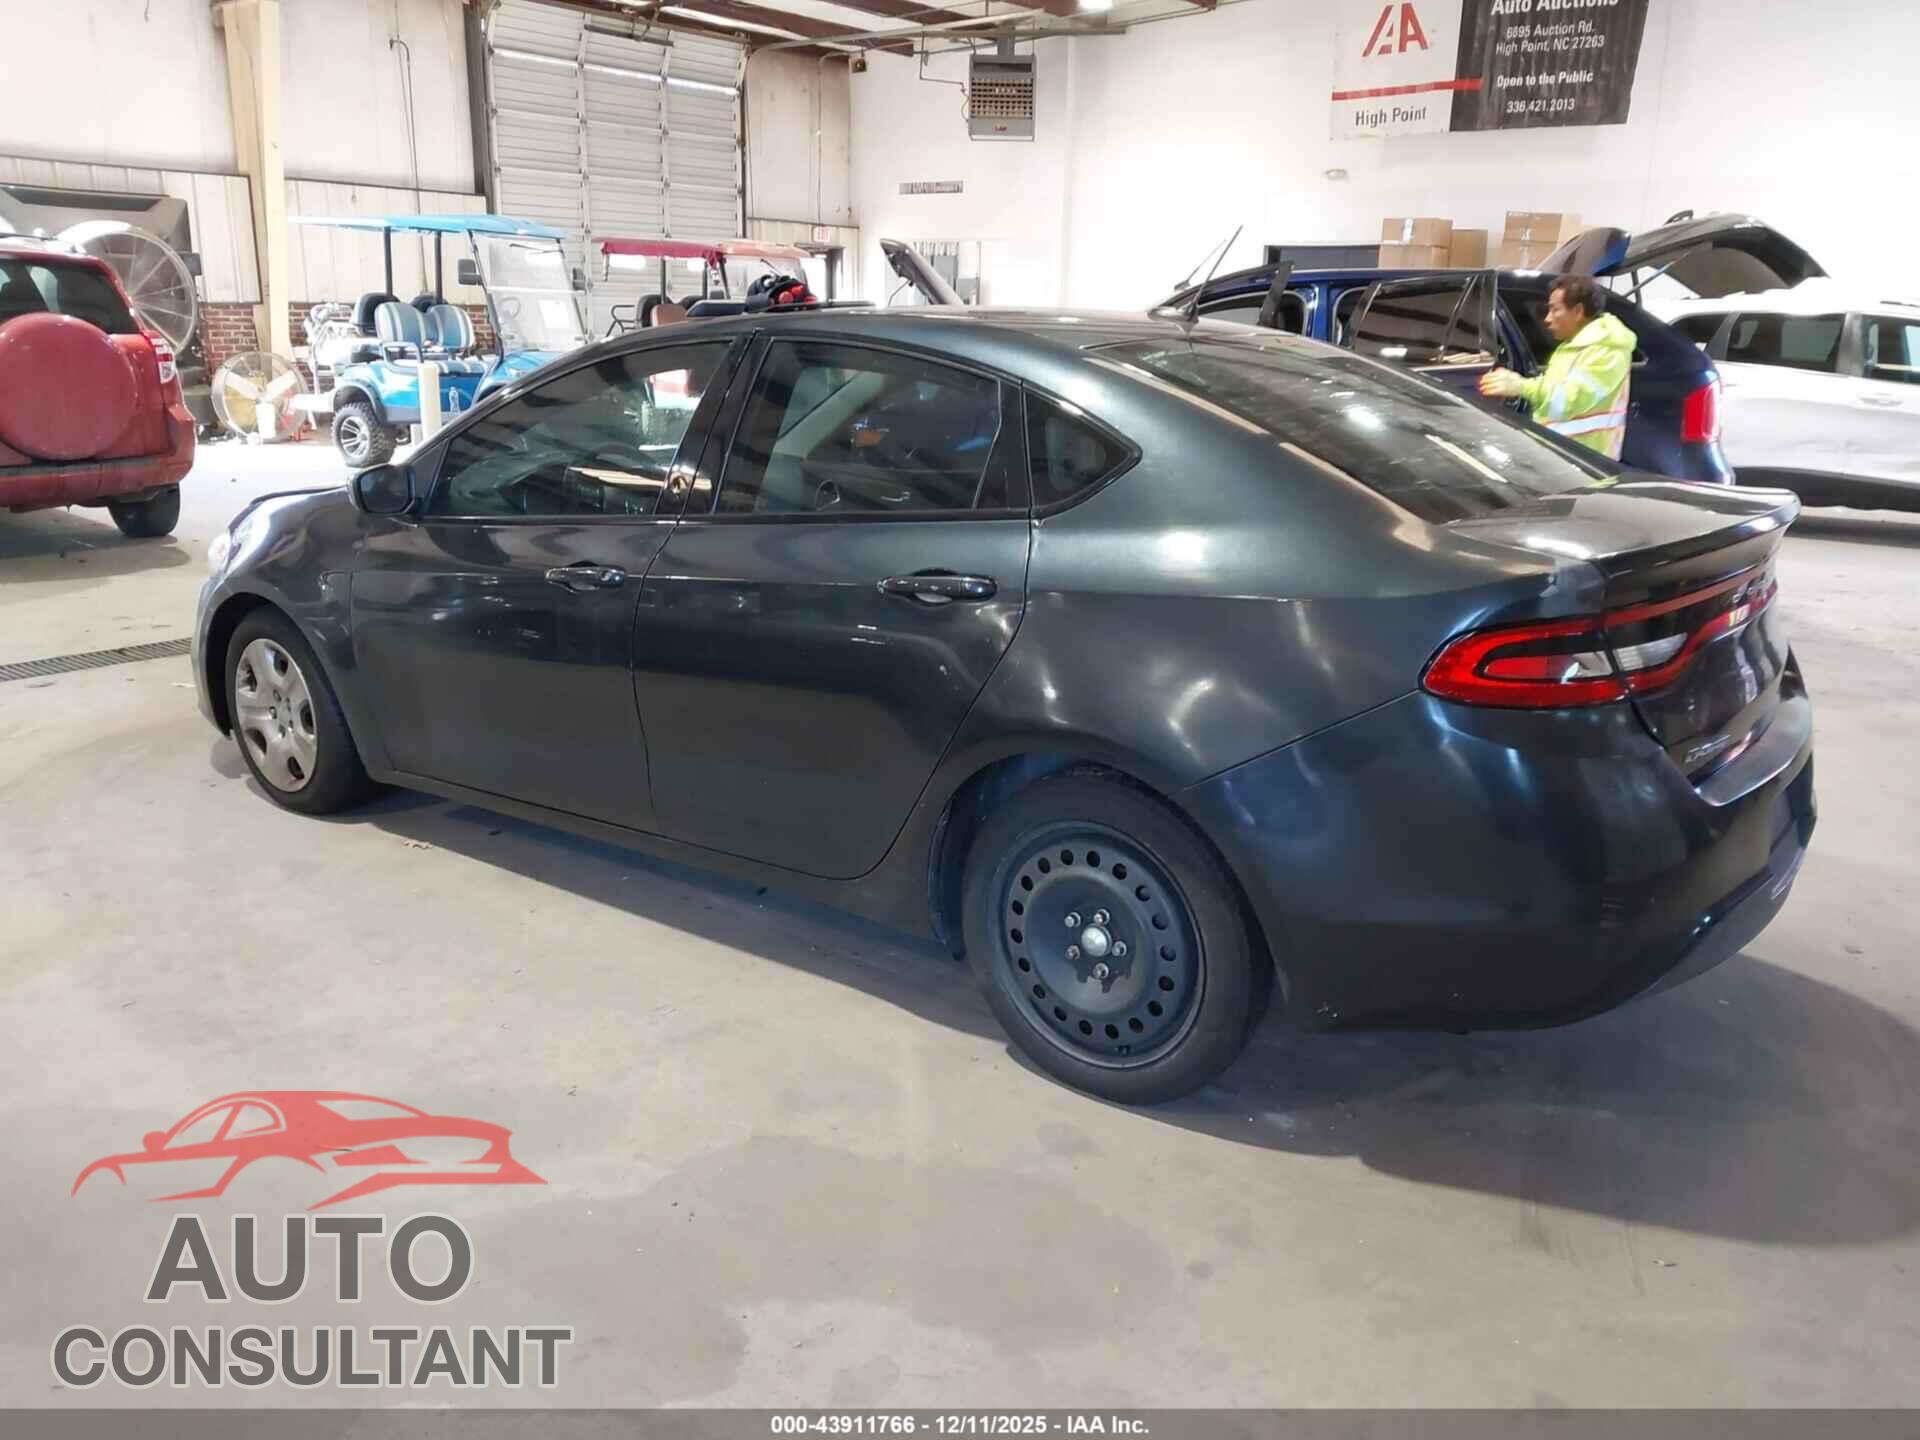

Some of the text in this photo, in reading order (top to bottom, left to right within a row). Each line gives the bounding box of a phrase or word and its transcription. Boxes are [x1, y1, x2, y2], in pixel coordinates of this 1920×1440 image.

[1490, 0, 1533, 15] Auto
[1533, 22, 1575, 36] Auction
[1495, 41, 1518, 56] High
[1553, 38, 1570, 51] NC
[1496, 70, 1594, 89] Open to the Public
[1355, 105, 1427, 128] High Point
